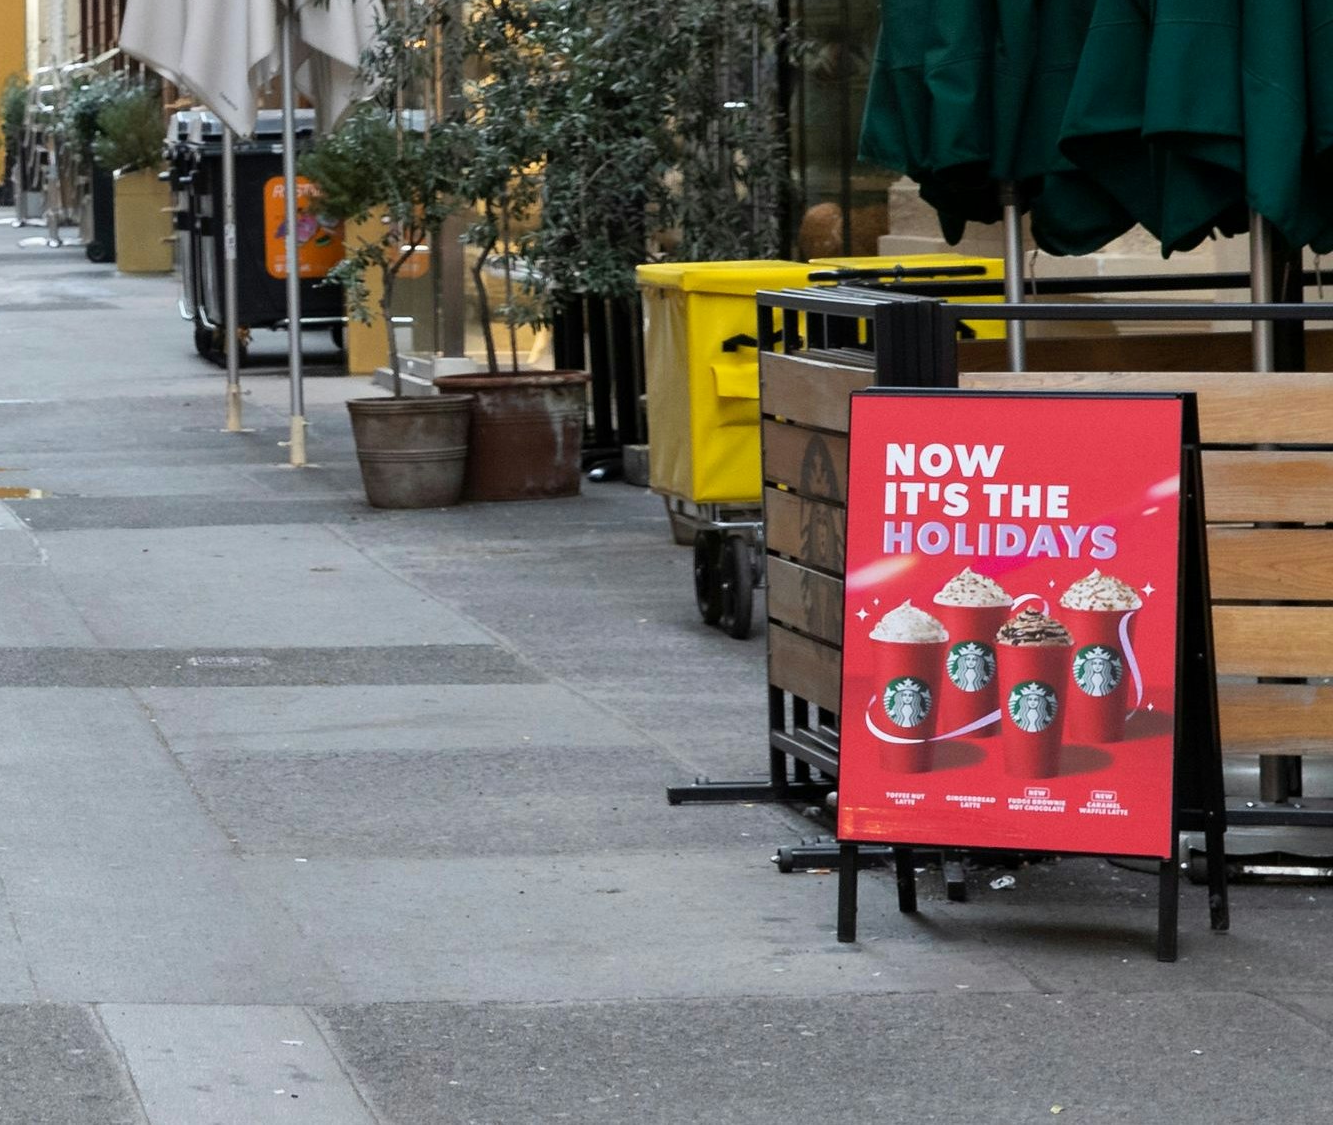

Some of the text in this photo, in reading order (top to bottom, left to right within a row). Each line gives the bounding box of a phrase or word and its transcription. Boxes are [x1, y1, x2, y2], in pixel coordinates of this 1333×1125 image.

[886, 443, 1005, 478] NOW
[884, 482, 1070, 519] IT'S THE
[883, 521, 1118, 560] HOLIDAYS
[1028, 789, 1047, 797] NEW
[1094, 792, 1113, 800] NEW
[895, 798, 916, 806] LATTE
[960, 801, 981, 809] LATTE
[1086, 801, 1121, 809] CARAMEL
